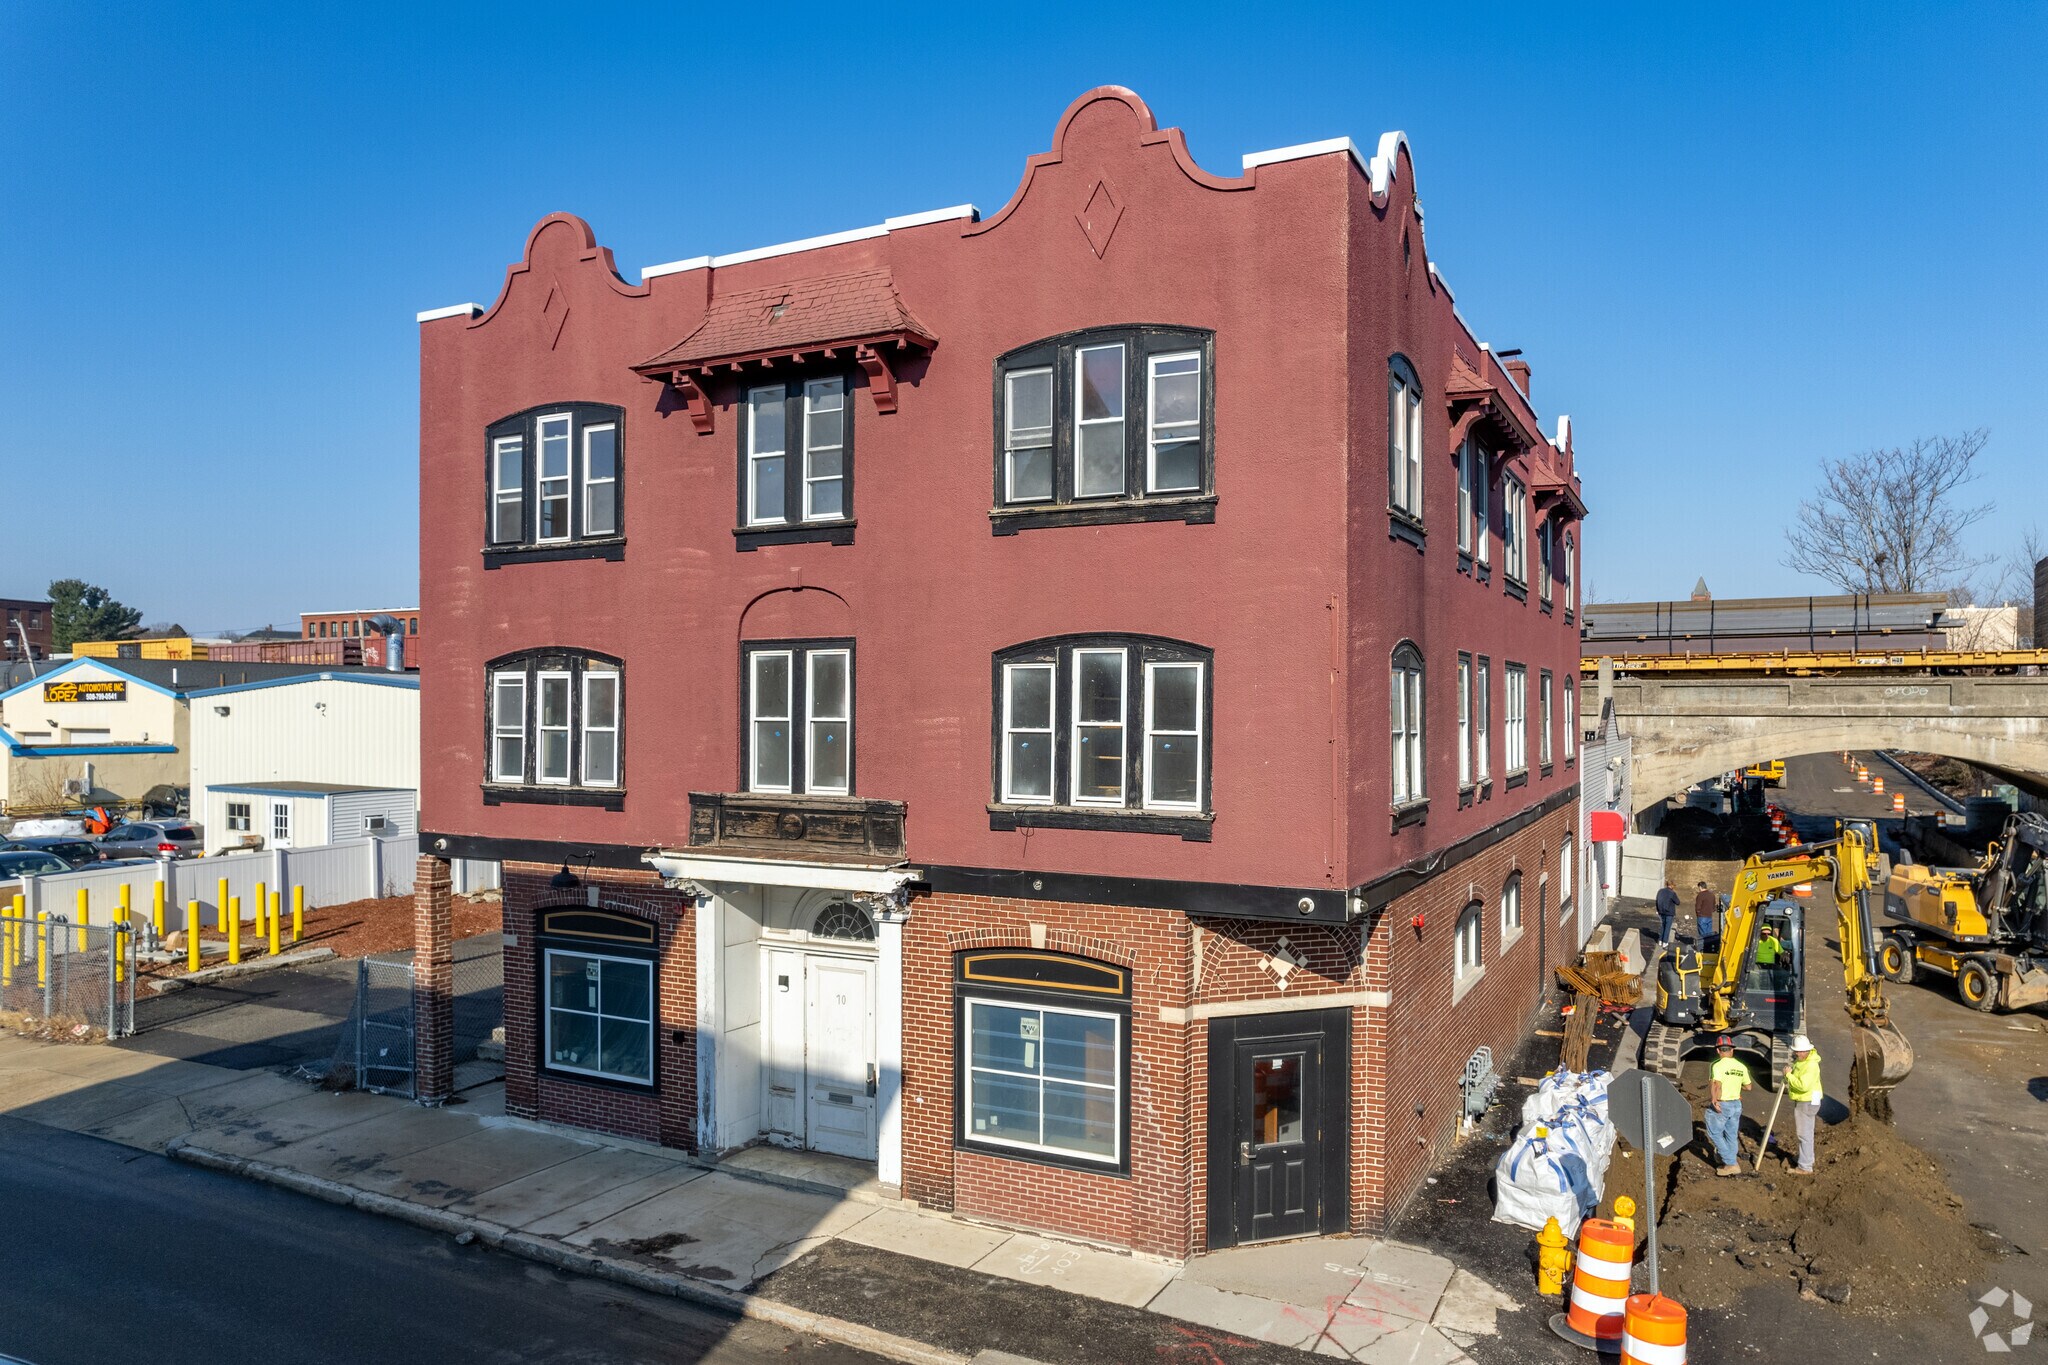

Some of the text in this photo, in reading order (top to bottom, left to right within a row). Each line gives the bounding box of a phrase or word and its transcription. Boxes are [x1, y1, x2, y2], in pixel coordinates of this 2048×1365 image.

[78, 683, 125, 692] AUTOMOTIVE INC.
[44, 690, 78, 702] LOPEZ
[1767, 870, 1794, 880] YANMAR
[836, 994, 846, 1005] 10
